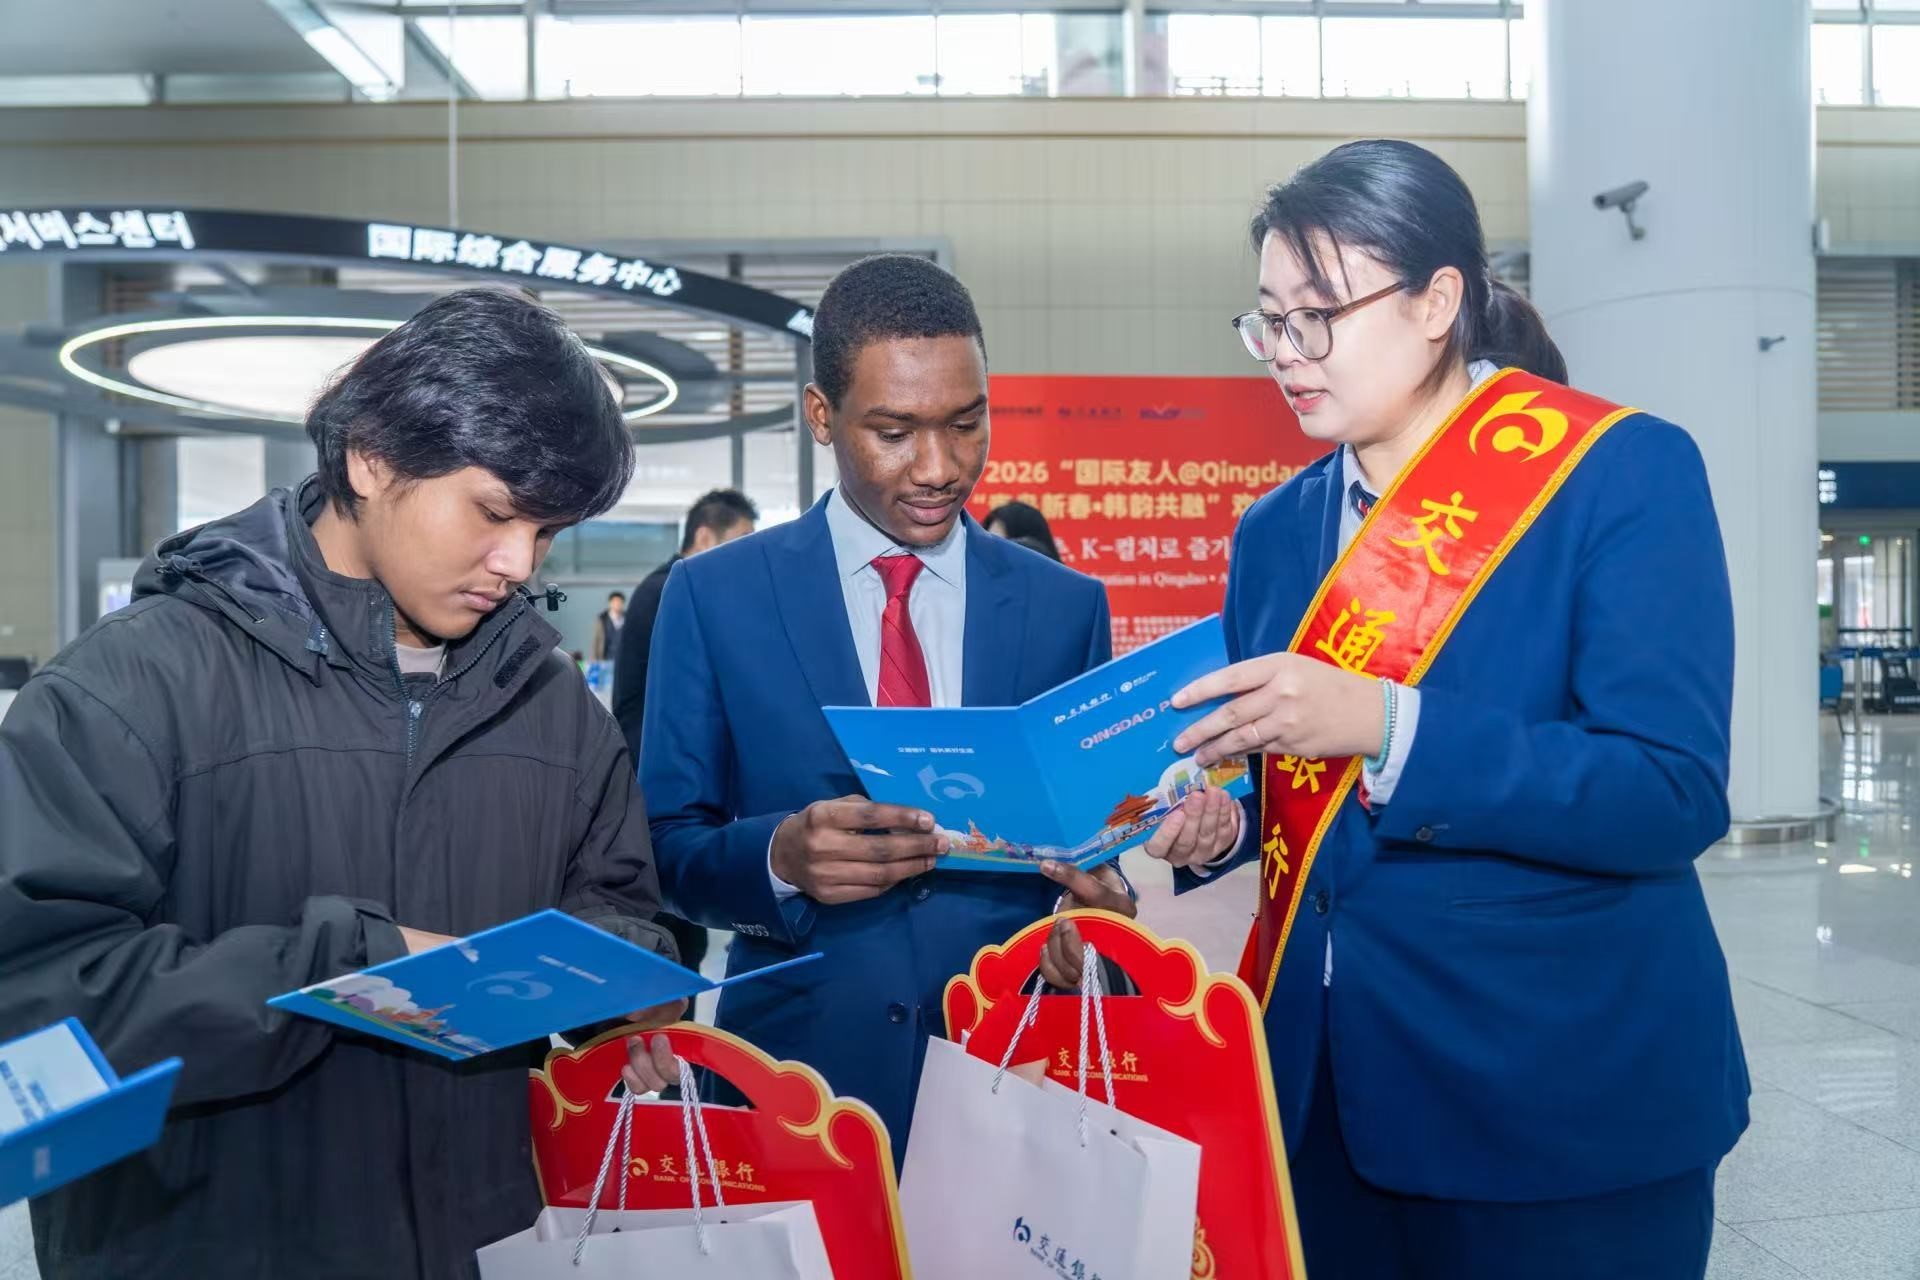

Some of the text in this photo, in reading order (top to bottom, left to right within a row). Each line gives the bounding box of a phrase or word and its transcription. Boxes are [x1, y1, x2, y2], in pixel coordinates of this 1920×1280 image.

[367, 223, 682, 296] 国际综合服务中心
[984, 459, 1049, 484] 2026
[1080, 707, 1156, 749] QINGDAO
